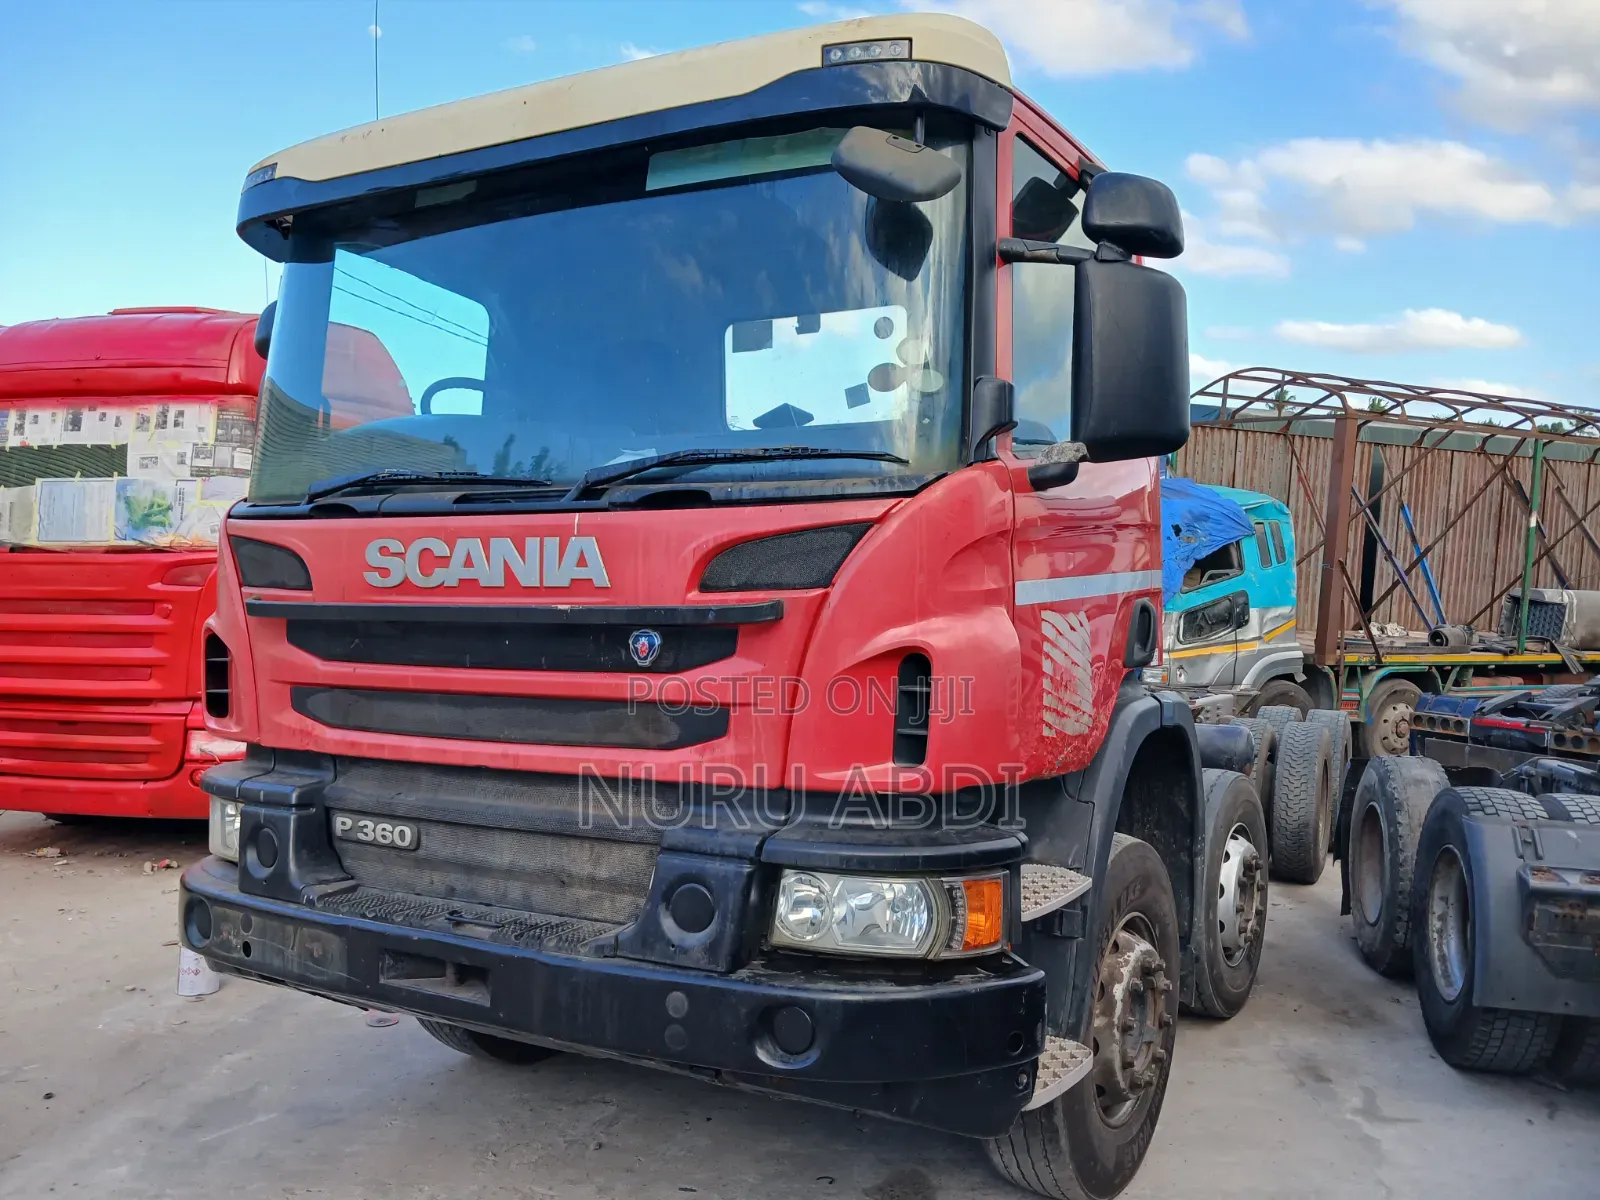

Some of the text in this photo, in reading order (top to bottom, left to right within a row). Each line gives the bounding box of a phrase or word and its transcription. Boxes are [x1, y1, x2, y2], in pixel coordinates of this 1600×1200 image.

[364, 537, 611, 588] SCANIA
[335, 817, 412, 847] P 360
